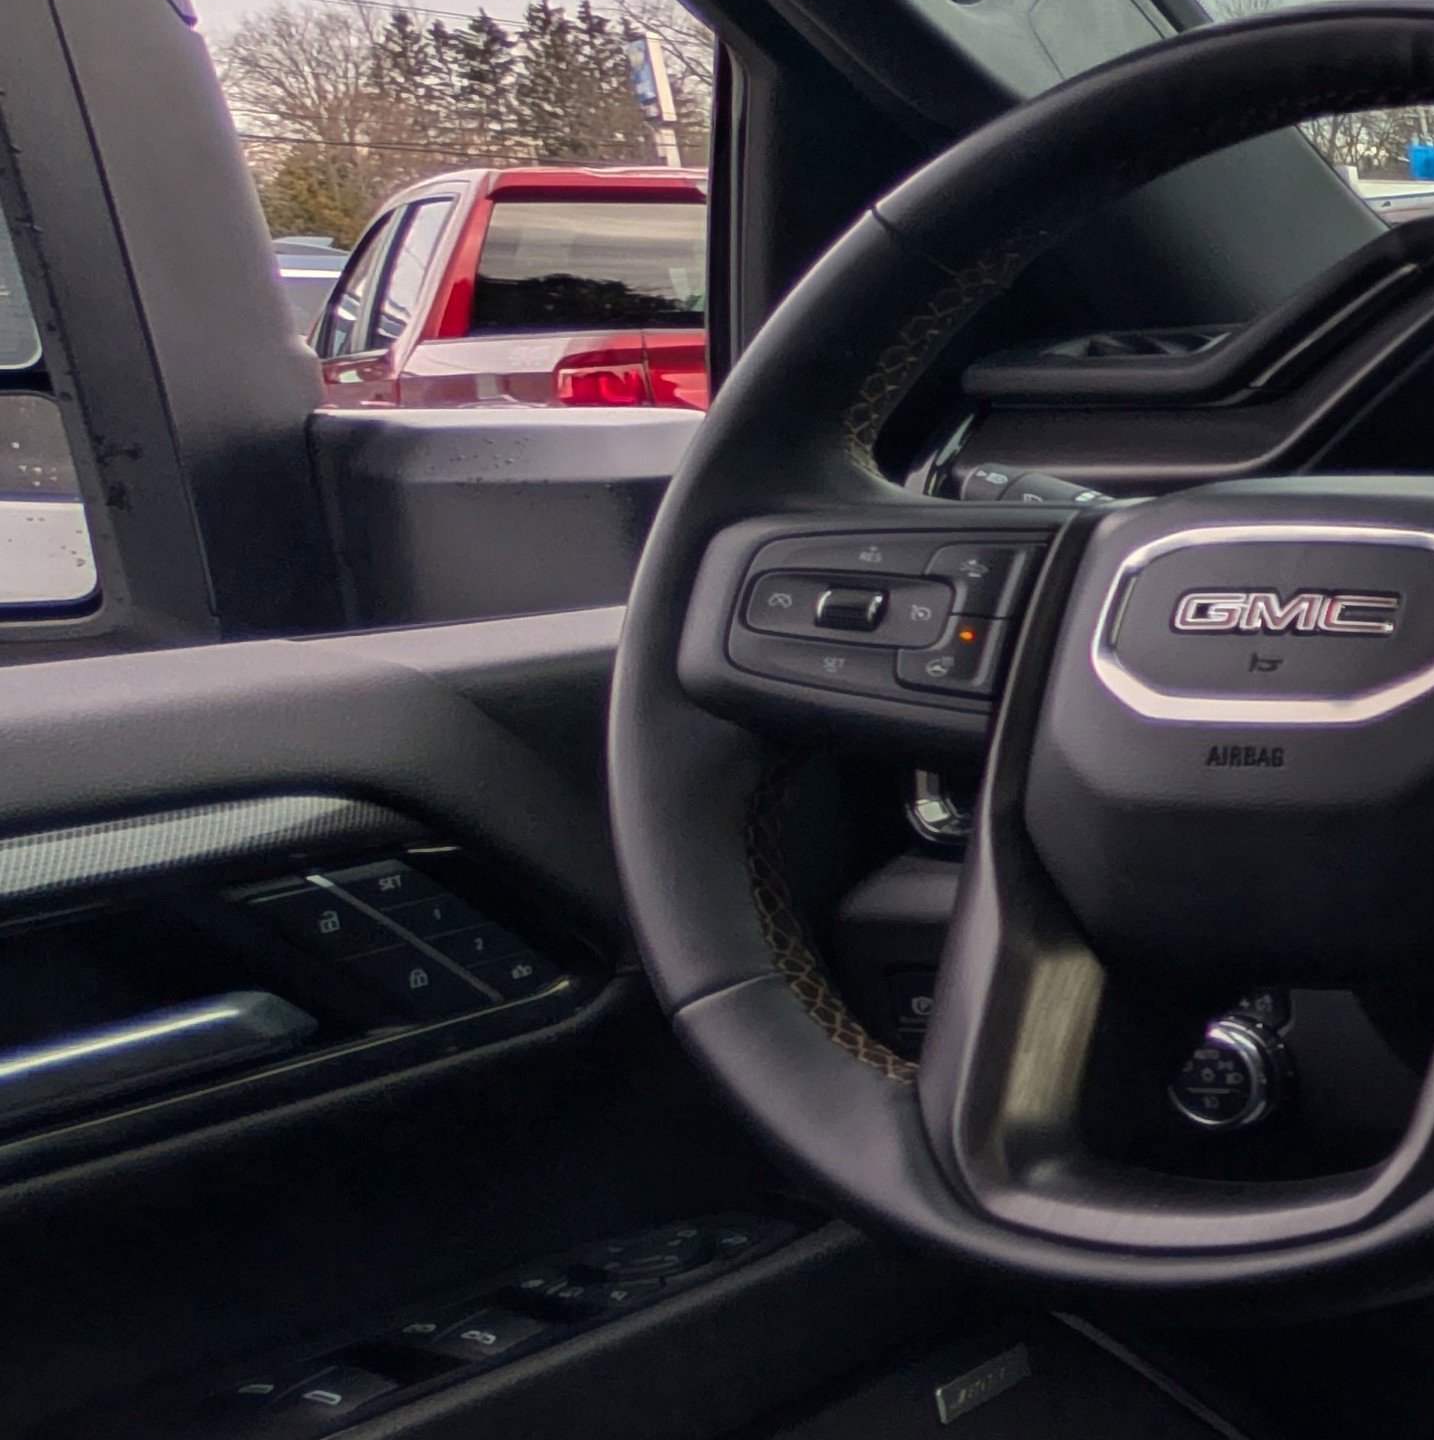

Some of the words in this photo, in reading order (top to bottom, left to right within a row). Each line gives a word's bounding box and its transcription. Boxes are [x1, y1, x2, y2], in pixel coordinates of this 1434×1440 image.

[1174, 592, 1399, 634] GMC
[1206, 746, 1285, 768] AIRBAG
[378, 874, 402, 892] SET
